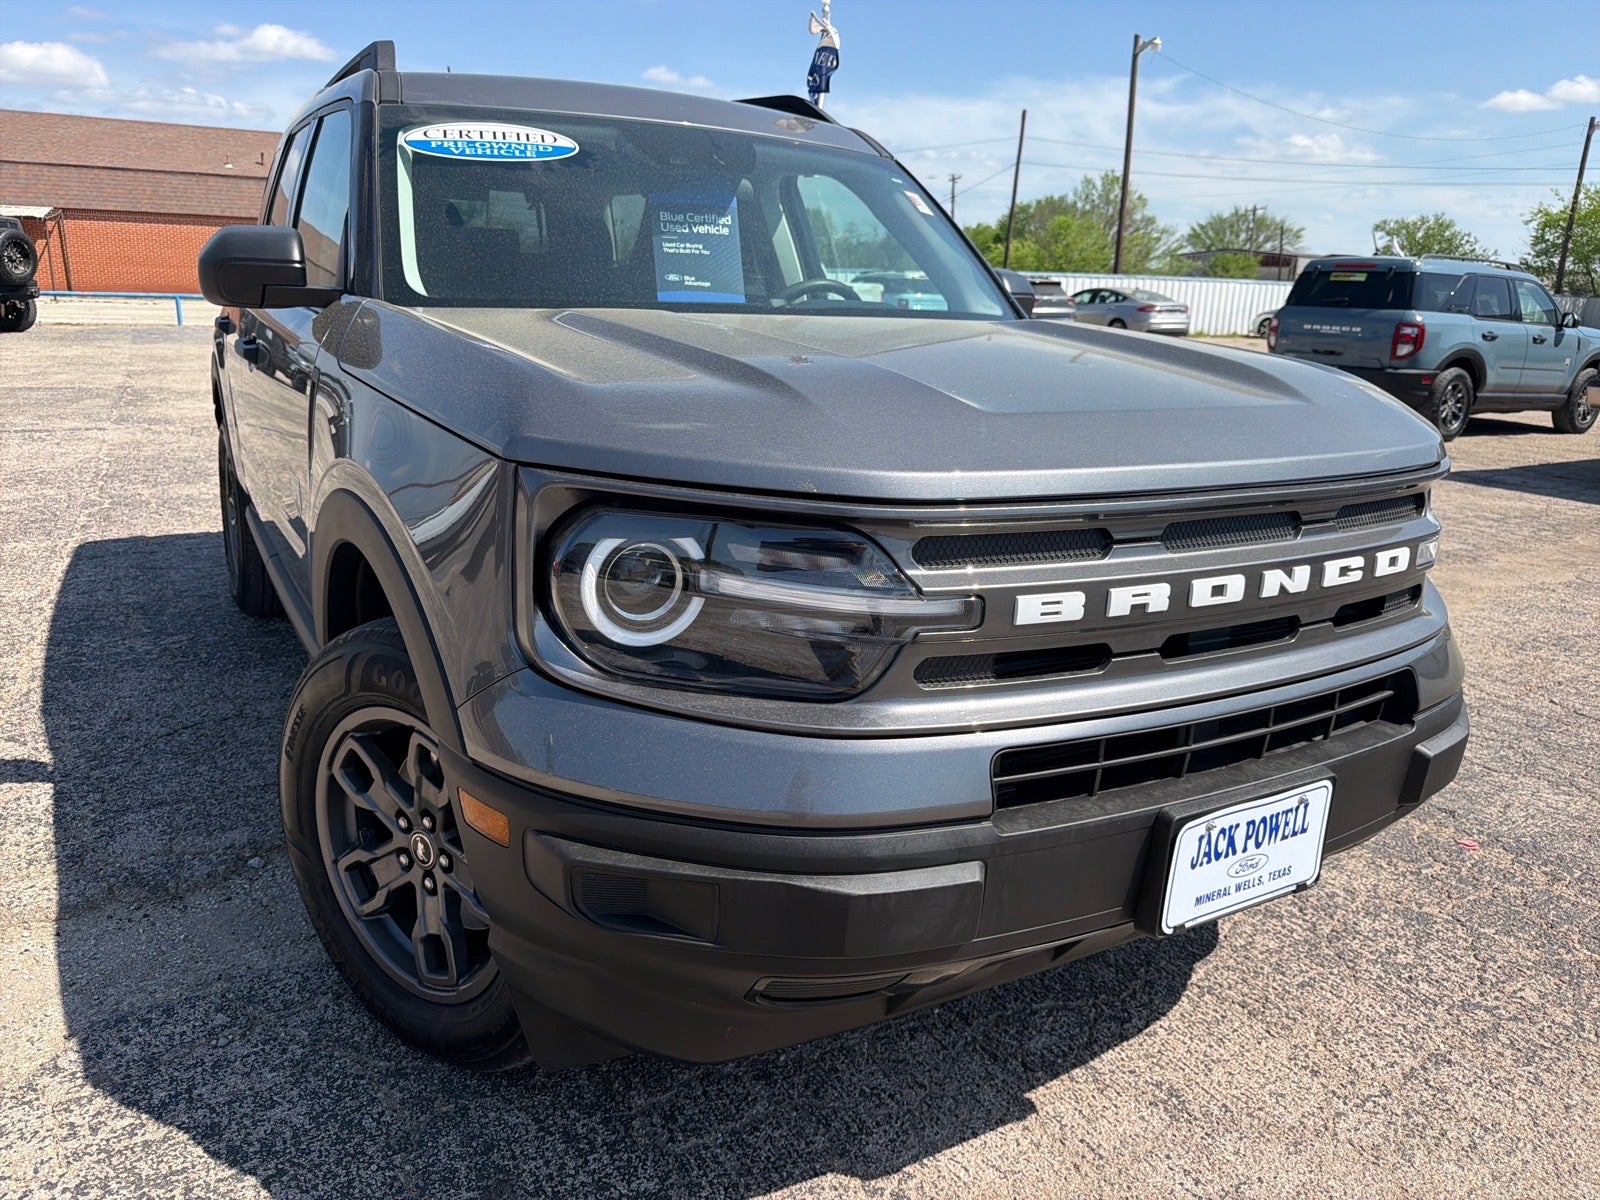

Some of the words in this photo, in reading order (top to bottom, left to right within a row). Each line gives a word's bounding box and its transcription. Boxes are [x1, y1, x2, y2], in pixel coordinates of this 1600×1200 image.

[423, 129, 557, 144] CERTIFIED
[430, 141, 553, 152] PRE-OWNED
[449, 147, 537, 158] VEHICLE
[660, 211, 684, 222] Blue
[686, 213, 732, 225] Certified
[660, 222, 689, 233] Used
[1013, 546, 1411, 626] BRONCO
[1190, 823, 1240, 870] JACK
[1241, 801, 1310, 853] POWELL
[1235, 857, 1263, 875] Ford
[1194, 885, 1232, 907] MINERAL
[1234, 875, 1265, 894] WELLS,
[1268, 865, 1293, 883] TEXAS
